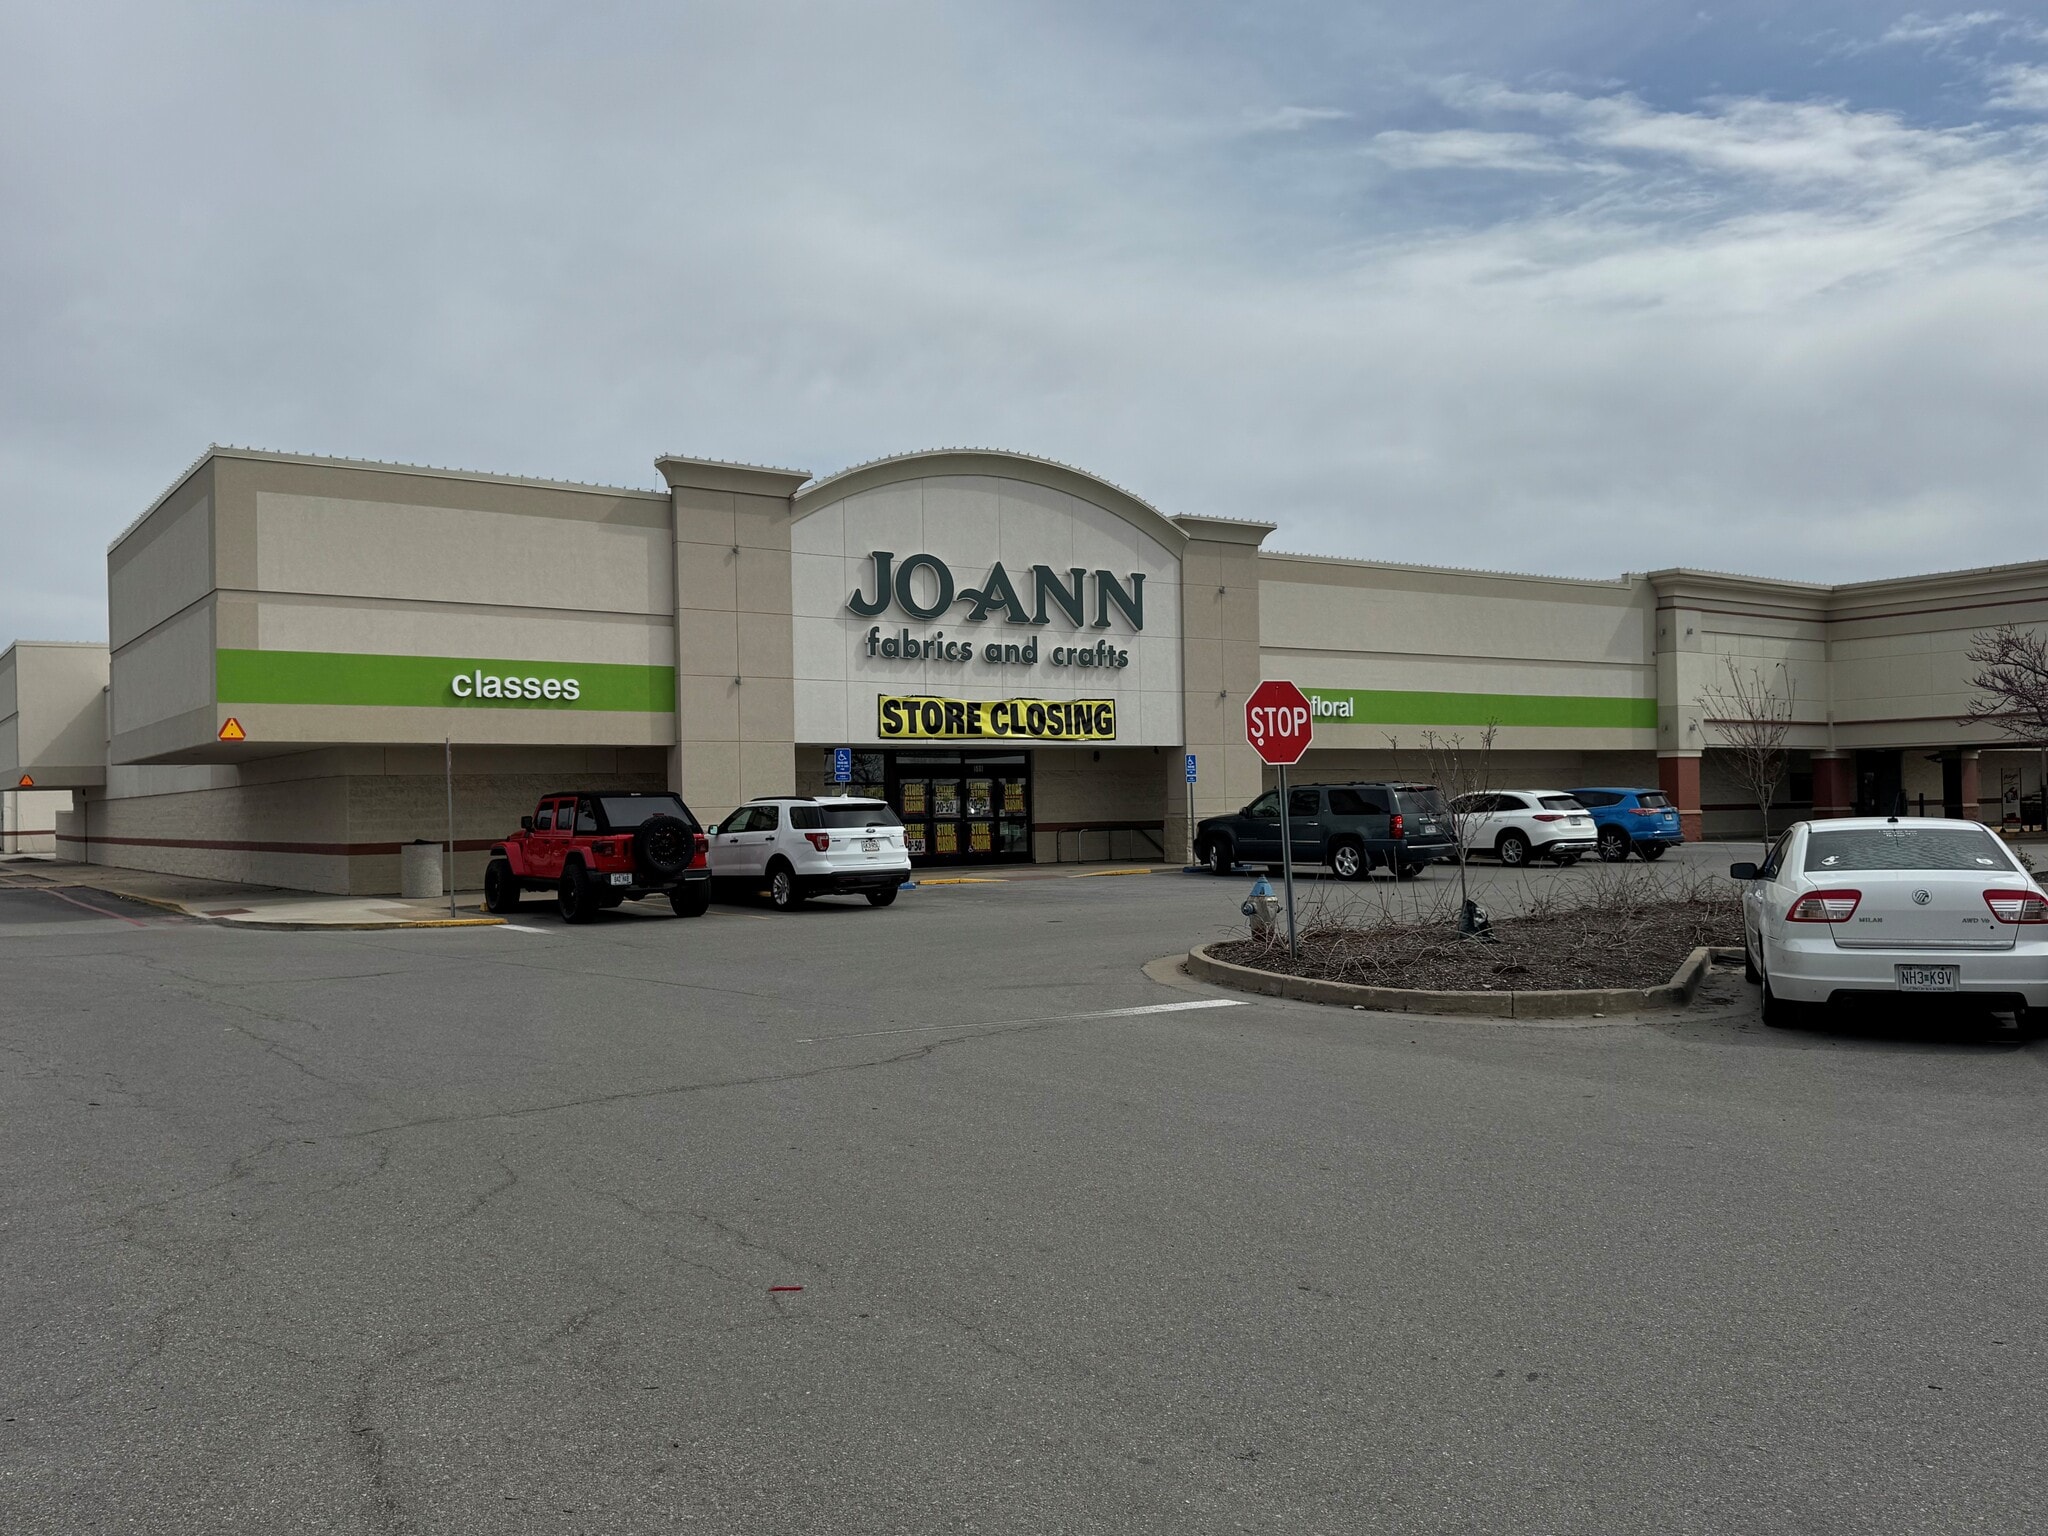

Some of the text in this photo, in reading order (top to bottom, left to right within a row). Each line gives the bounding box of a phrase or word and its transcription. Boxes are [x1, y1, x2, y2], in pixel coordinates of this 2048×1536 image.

[865, 626, 1130, 668] fabrics and crafts
[452, 669, 581, 700] classes
[882, 700, 1113, 736] STORE CLOSING
[1250, 706, 1308, 737] STOP
[1311, 695, 1354, 717] floral
